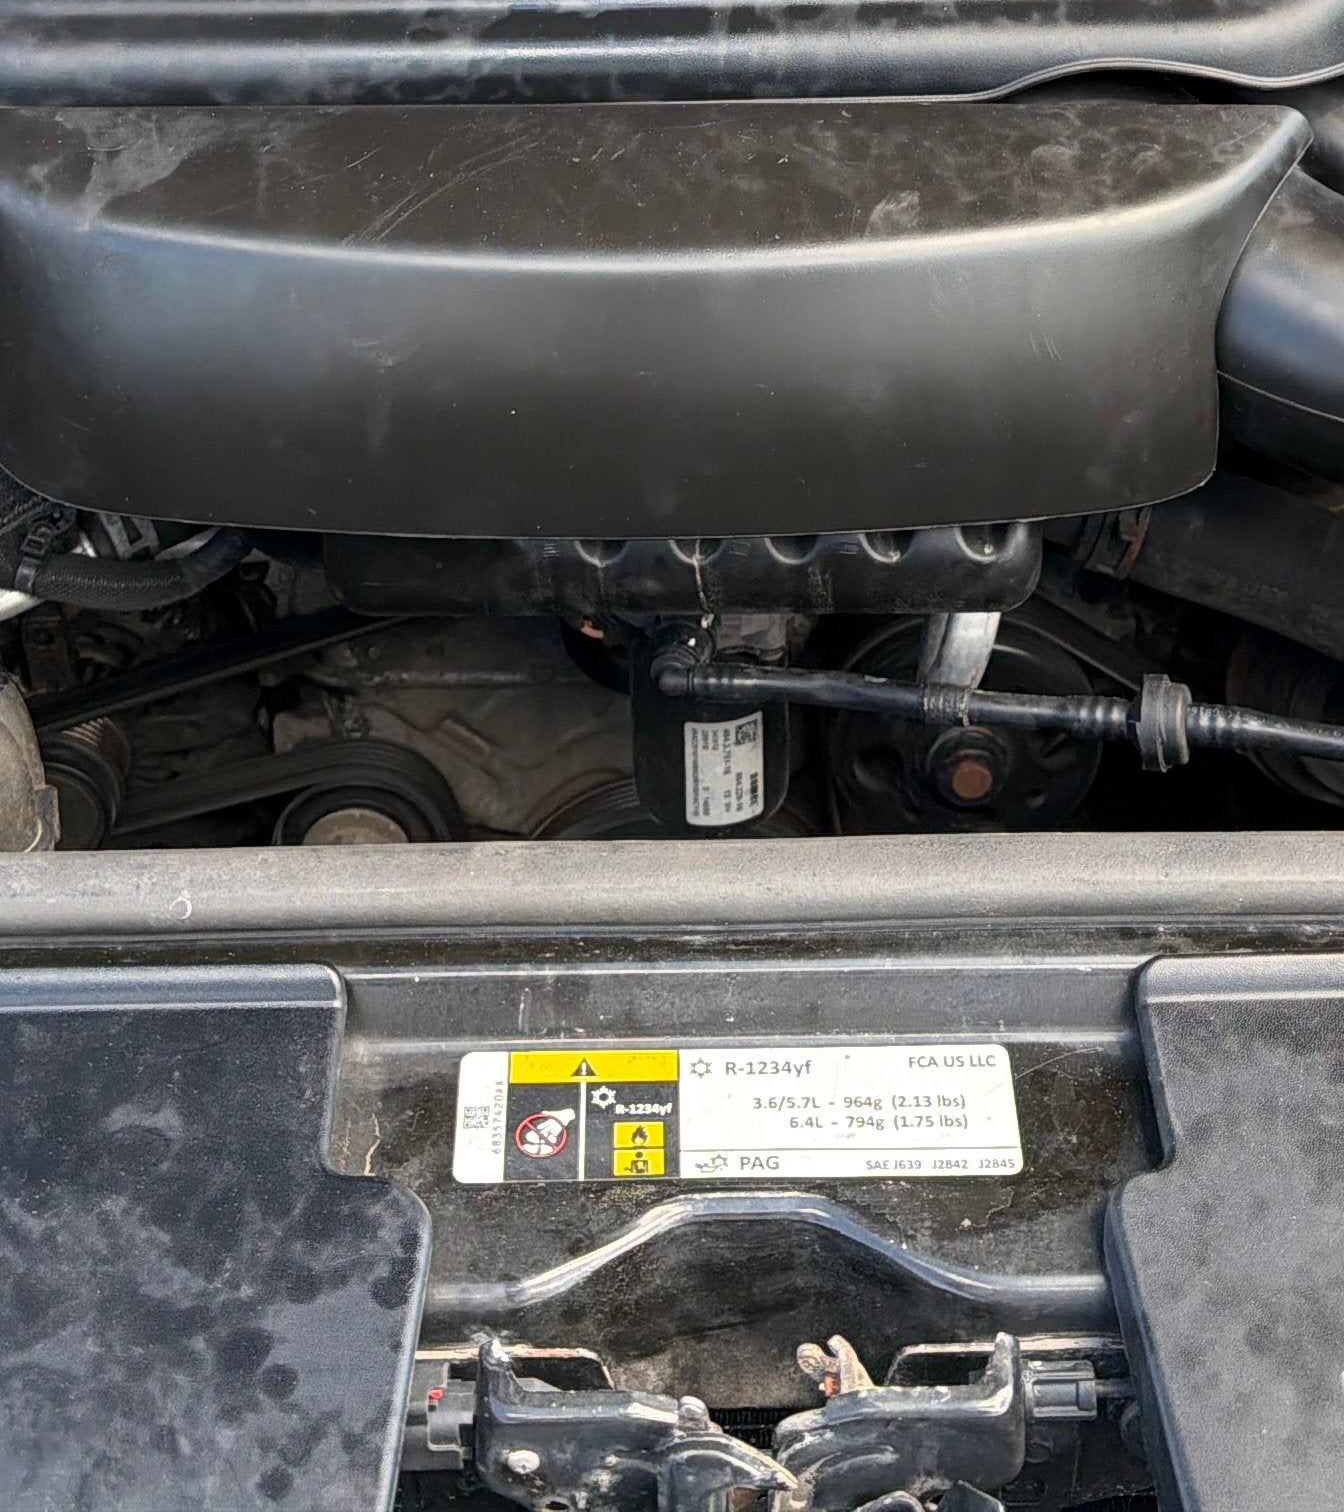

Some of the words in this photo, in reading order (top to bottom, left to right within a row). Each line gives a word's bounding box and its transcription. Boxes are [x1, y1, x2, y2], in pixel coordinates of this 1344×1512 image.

[725, 1059, 812, 1078] R-1234yf
[908, 1055, 940, 1069] FCA
[943, 1055, 965, 1068] US
[970, 1054, 996, 1067] LLC
[615, 1102, 673, 1116] R-1234yf
[752, 1096, 820, 1111] 3.6/5.7L
[843, 1096, 883, 1111] 964g
[891, 1095, 932, 1110] (2.13
[937, 1094, 966, 1110] lbs)
[789, 1117, 824, 1129] 6.4L
[846, 1116, 884, 1131] 794g
[893, 1115, 935, 1129] (1.75
[939, 1114, 968, 1129] lbs)
[740, 1155, 780, 1170] PAG
[866, 1159, 890, 1170] SAE
[892, 1159, 922, 1170] J639
[932, 1159, 969, 1170] J2842
[979, 1158, 1016, 1169] J2845
